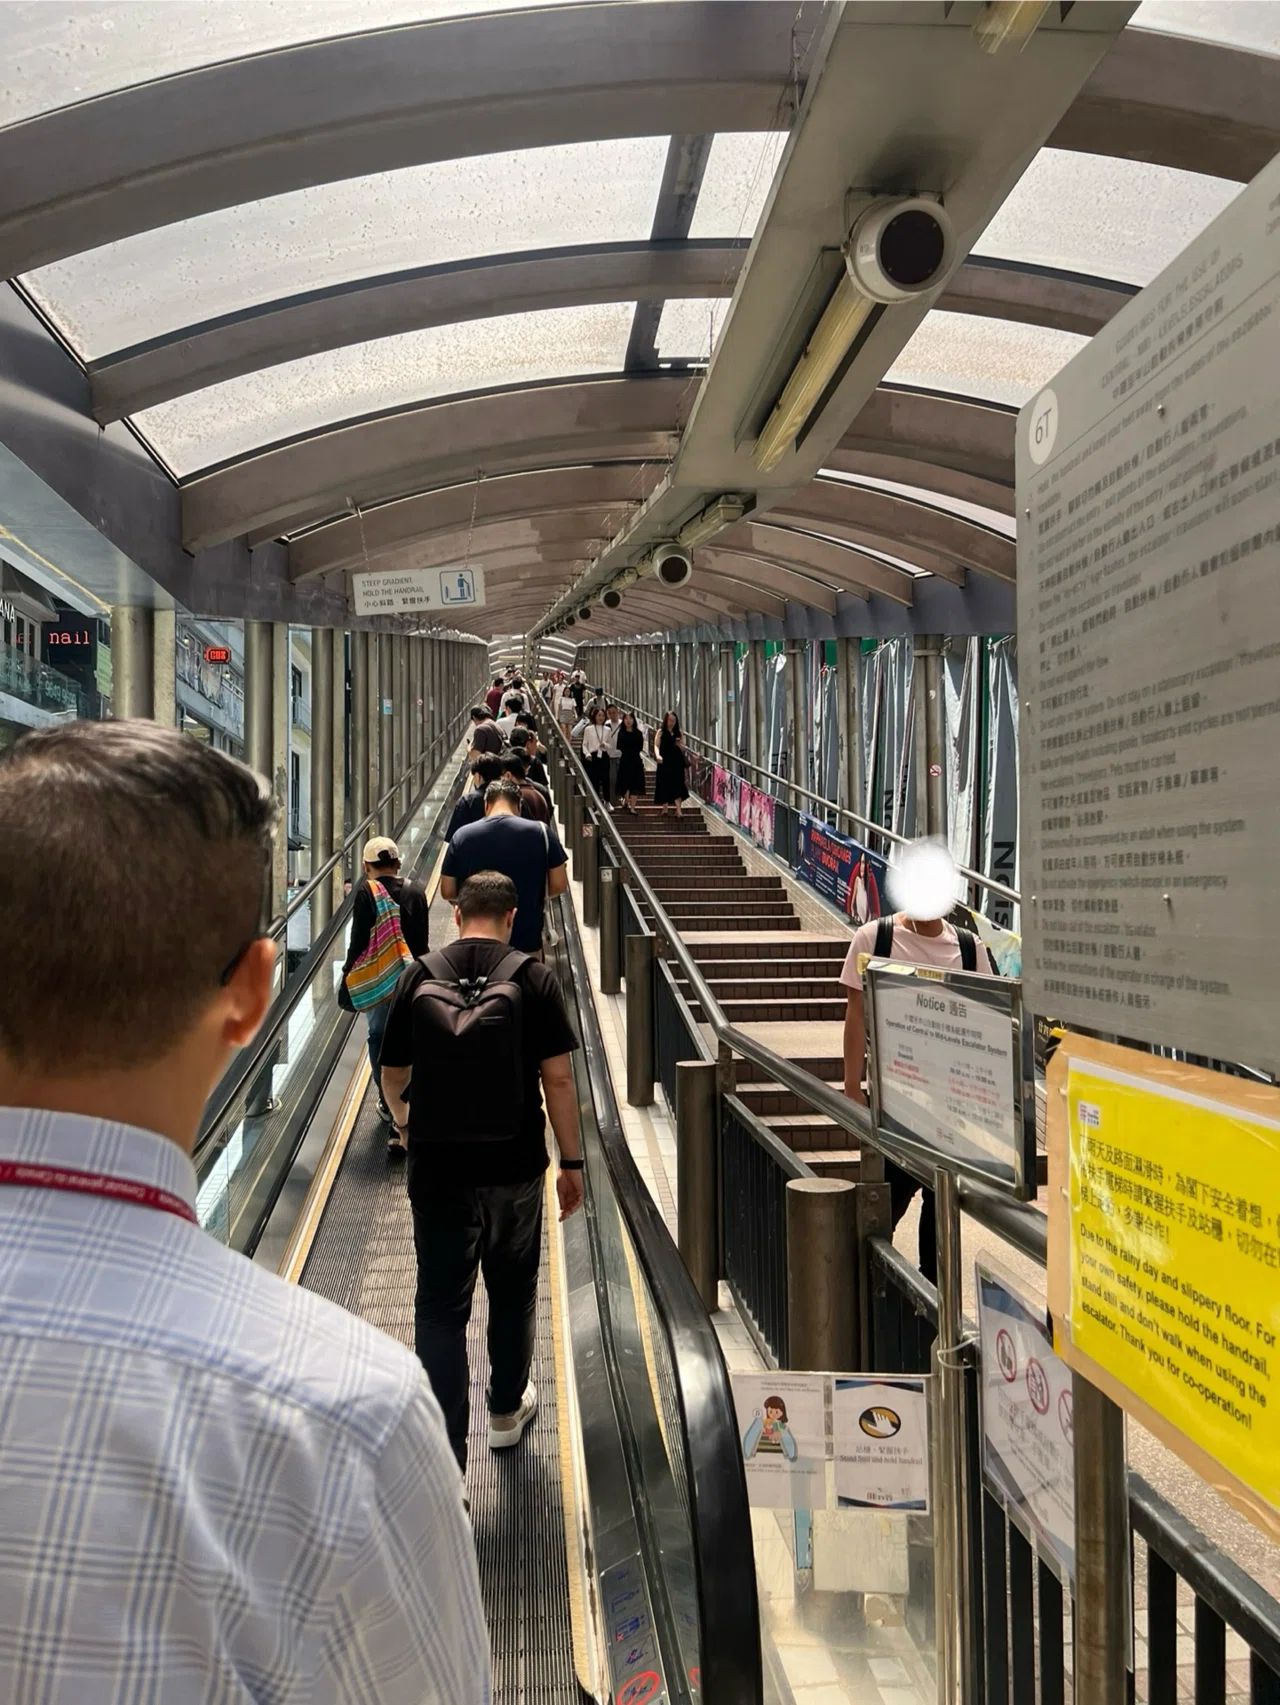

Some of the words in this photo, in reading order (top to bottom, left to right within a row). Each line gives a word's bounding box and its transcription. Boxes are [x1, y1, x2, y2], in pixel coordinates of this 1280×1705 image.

[1036, 408, 1052, 444] 6T
[363, 589, 379, 597] HOLD
[382, 588, 392, 596] THE
[383, 577, 412, 586] GRADIENT
[49, 631, 90, 644] nail
[916, 993, 945, 1012] Notice
[949, 1000, 967, 1019] 通告
[886, 1018, 906, 1032] Operation
[912, 1025, 929, 1036] Central
[935, 1031, 961, 1045] Mid-Levels
[962, 1038, 986, 1051] Escalator
[987, 1044, 1007, 1057] System
[1080, 1223, 1095, 1242] Due
[1096, 1232, 1103, 1246] to
[1106, 1238, 1117, 1255] the
[1120, 1248, 1140, 1272] rainy
[1143, 1261, 1159, 1282] day
[1161, 1272, 1178, 1291] and
[1181, 1282, 1222, 1319] slippery
[1224, 1304, 1253, 1335] floor.
[1256, 1323, 1277, 1349] For
[1081, 1252, 1098, 1268] your
[1099, 1262, 1115, 1279] own
[1146, 1290, 1175, 1317] please
[1177, 1305, 1200, 1333] hold
[1202, 1323, 1219, 1345] the
[1221, 1334, 1271, 1381] handrail,
[1081, 1275, 1102, 1298] stand
[1103, 1288, 1117, 1307] still
[1119, 1299, 1135, 1320] and
[1137, 1309, 1160, 1337] don't
[1162, 1327, 1183, 1351] walk
[1186, 1342, 1212, 1370] when
[1215, 1362, 1246, 1397] using
[1248, 1383, 1267, 1408] the
[1082, 1301, 1118, 1335] escalator.
[1120, 1323, 1145, 1353] Thank
[1147, 1347, 1165, 1367] you
[1167, 1356, 1181, 1377] for
[1183, 1371, 1252, 1427] co-operation!
